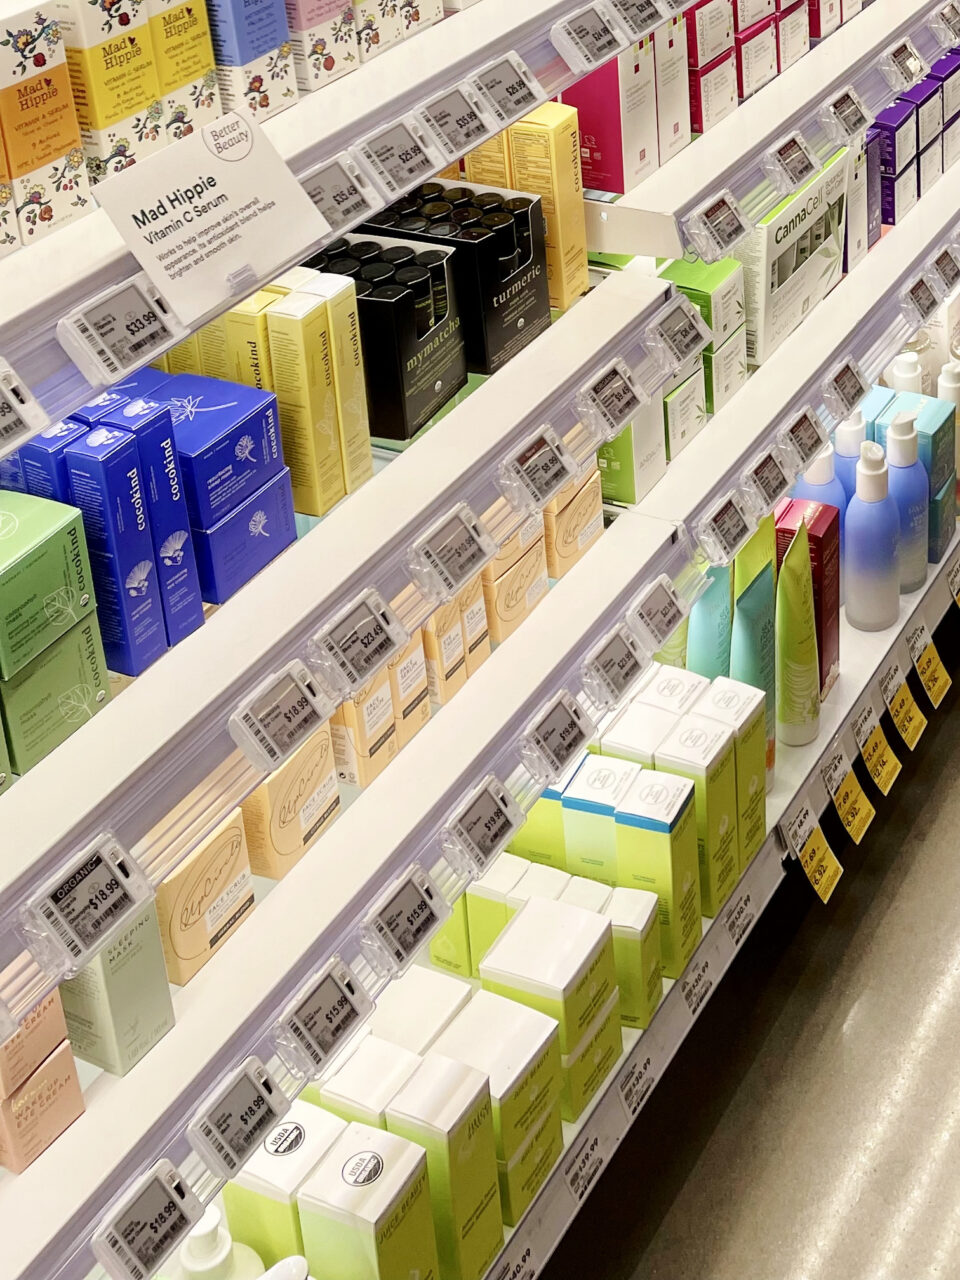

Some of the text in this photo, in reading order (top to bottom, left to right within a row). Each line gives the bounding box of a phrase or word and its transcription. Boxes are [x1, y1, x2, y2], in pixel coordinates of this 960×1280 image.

[162, 9, 185, 28] Mad
[164, 16, 198, 39] Hippie
[101, 37, 128, 59] Mad
[104, 45, 142, 71] Hippie
[16, 80, 43, 100] Mad
[19, 87, 59, 112] Hippie
[210, 120, 241, 143] Better
[214, 129, 250, 155] Beauty
[398, 145, 422, 164] $25.99
[571, 130, 580, 193] cocokind
[131, 174, 218, 230] Mad Hippie
[332, 185, 359, 205] $35.49
[143, 192, 229, 245] Vitamin C Serum
[156, 246, 177, 263] Works
[183, 235, 197, 248] help
[197, 221, 222, 241] improve
[221, 210, 239, 225] skin's
[238, 197, 260, 215] overall
[775, 187, 824, 245] CannaCell
[163, 247, 198, 271] appearance.
[206, 222, 241, 244] antioxidant
[240, 210, 259, 226] blend
[258, 199, 276, 217] helps
[168, 233, 242, 281] brighten and smooth skin.
[492, 263, 542, 308] turmeric
[125, 311, 157, 336] $33.99
[350, 311, 360, 367] cocokind
[249, 340, 262, 391] ocokind
[321, 330, 332, 386] cocokind
[265, 408, 277, 459] cocokind
[160, 438, 180, 502] cocokind
[127, 467, 145, 532] cocokind
[67, 526, 85, 592] cocokind
[361, 624, 383, 649] $23.49
[82, 625, 101, 688] cocokind
[284, 697, 309, 723] $18.99
[559, 721, 578, 741] $19.99
[485, 808, 504, 832] $19.99
[803, 848, 817, 869] $7.69
[57, 861, 96, 899] ORGANIC
[89, 878, 119, 910] $18.99
[208, 873, 247, 915] FACE SCRUB
[407, 900, 428, 927] $15.99
[108, 914, 150, 956] SLEEPING
[110, 942, 133, 963] MASK
[25, 998, 55, 1030] CREAM
[325, 995, 348, 1024] $15.99
[15, 1093, 44, 1120] WAKE
[16, 1108, 35, 1129] EYE
[39, 1075, 72, 1109] CREAM
[240, 1095, 265, 1126] $18.99
[270, 1127, 290, 1146] USDA
[349, 1157, 367, 1177] USDA
[150, 1201, 177, 1234] $18.99
[378, 1172, 427, 1245] JUICE BEAUTY
